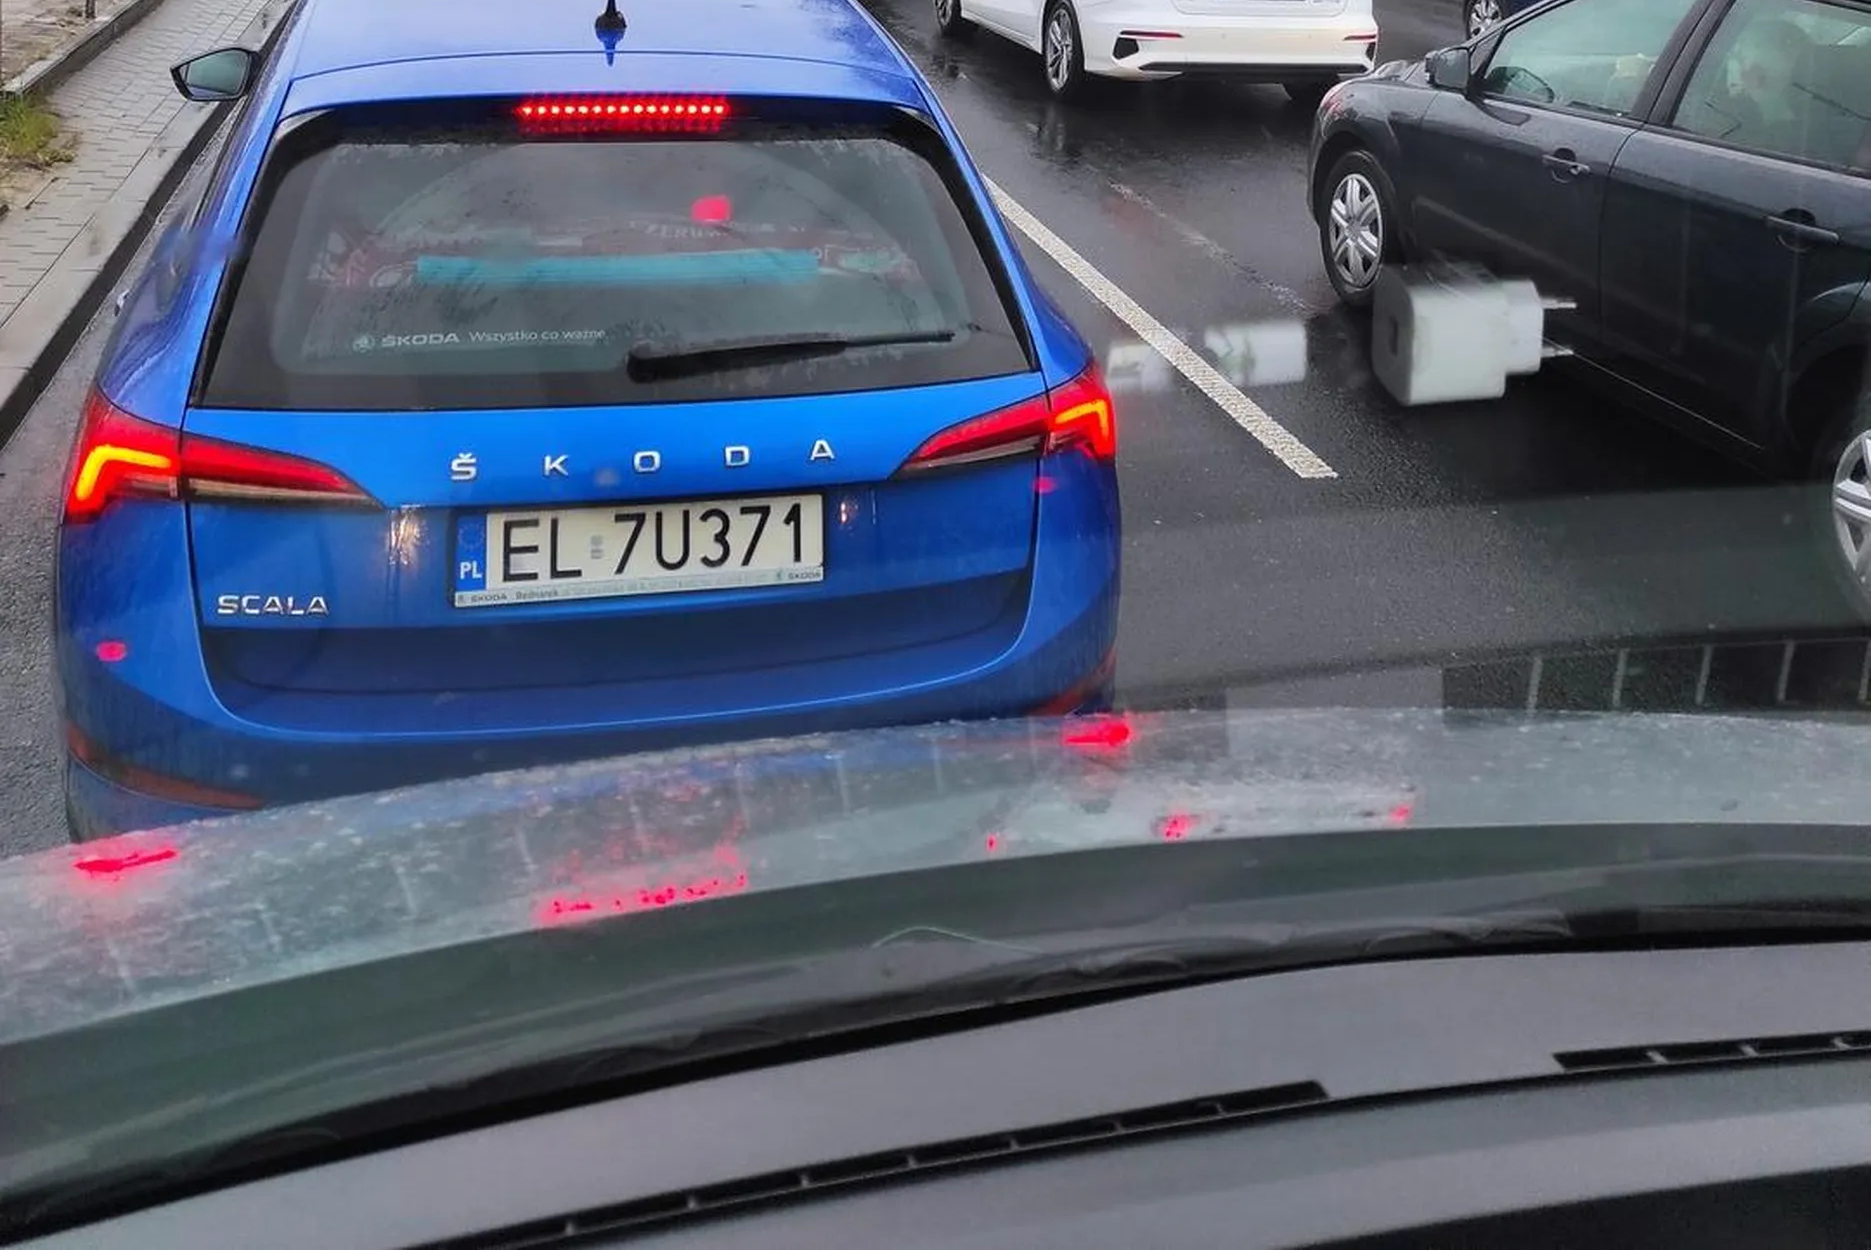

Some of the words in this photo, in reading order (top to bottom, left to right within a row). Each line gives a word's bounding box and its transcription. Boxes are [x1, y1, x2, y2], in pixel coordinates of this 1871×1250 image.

[468, 330, 538, 344] Wszystko
[541, 330, 559, 340] co
[450, 438, 834, 481] ŠKODA
[503, 517, 582, 582] EL
[614, 502, 802, 575] 7U371
[459, 561, 483, 580] PL
[217, 595, 328, 614] SCALA
